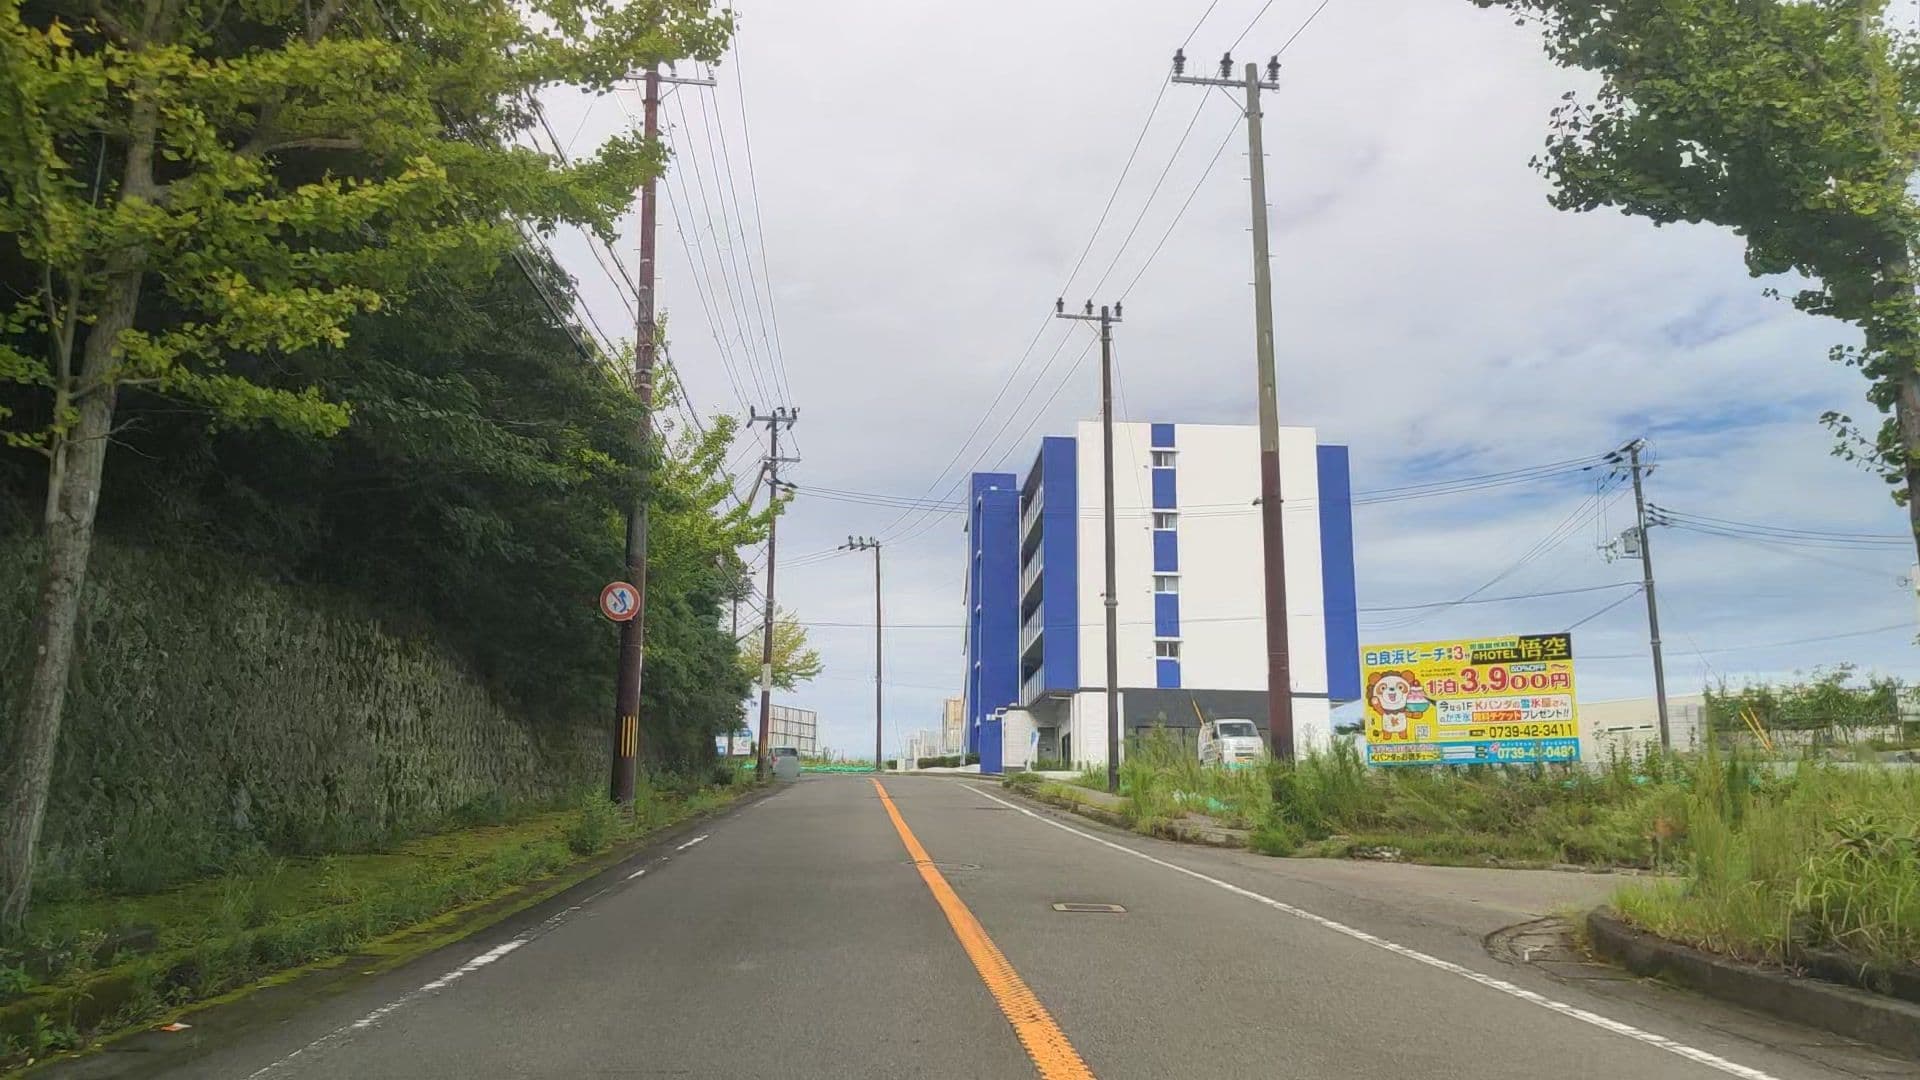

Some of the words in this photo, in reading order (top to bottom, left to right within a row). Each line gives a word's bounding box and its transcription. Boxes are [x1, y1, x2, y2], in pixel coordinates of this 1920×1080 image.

[1478, 649, 1518, 661] HOTEL
[1518, 636, 1568, 659] 悟空
[1425, 678, 1458, 695] 1泊
[1459, 667, 1571, 694] 3,900円
[1488, 724, 1572, 738] 0739-42-3411
